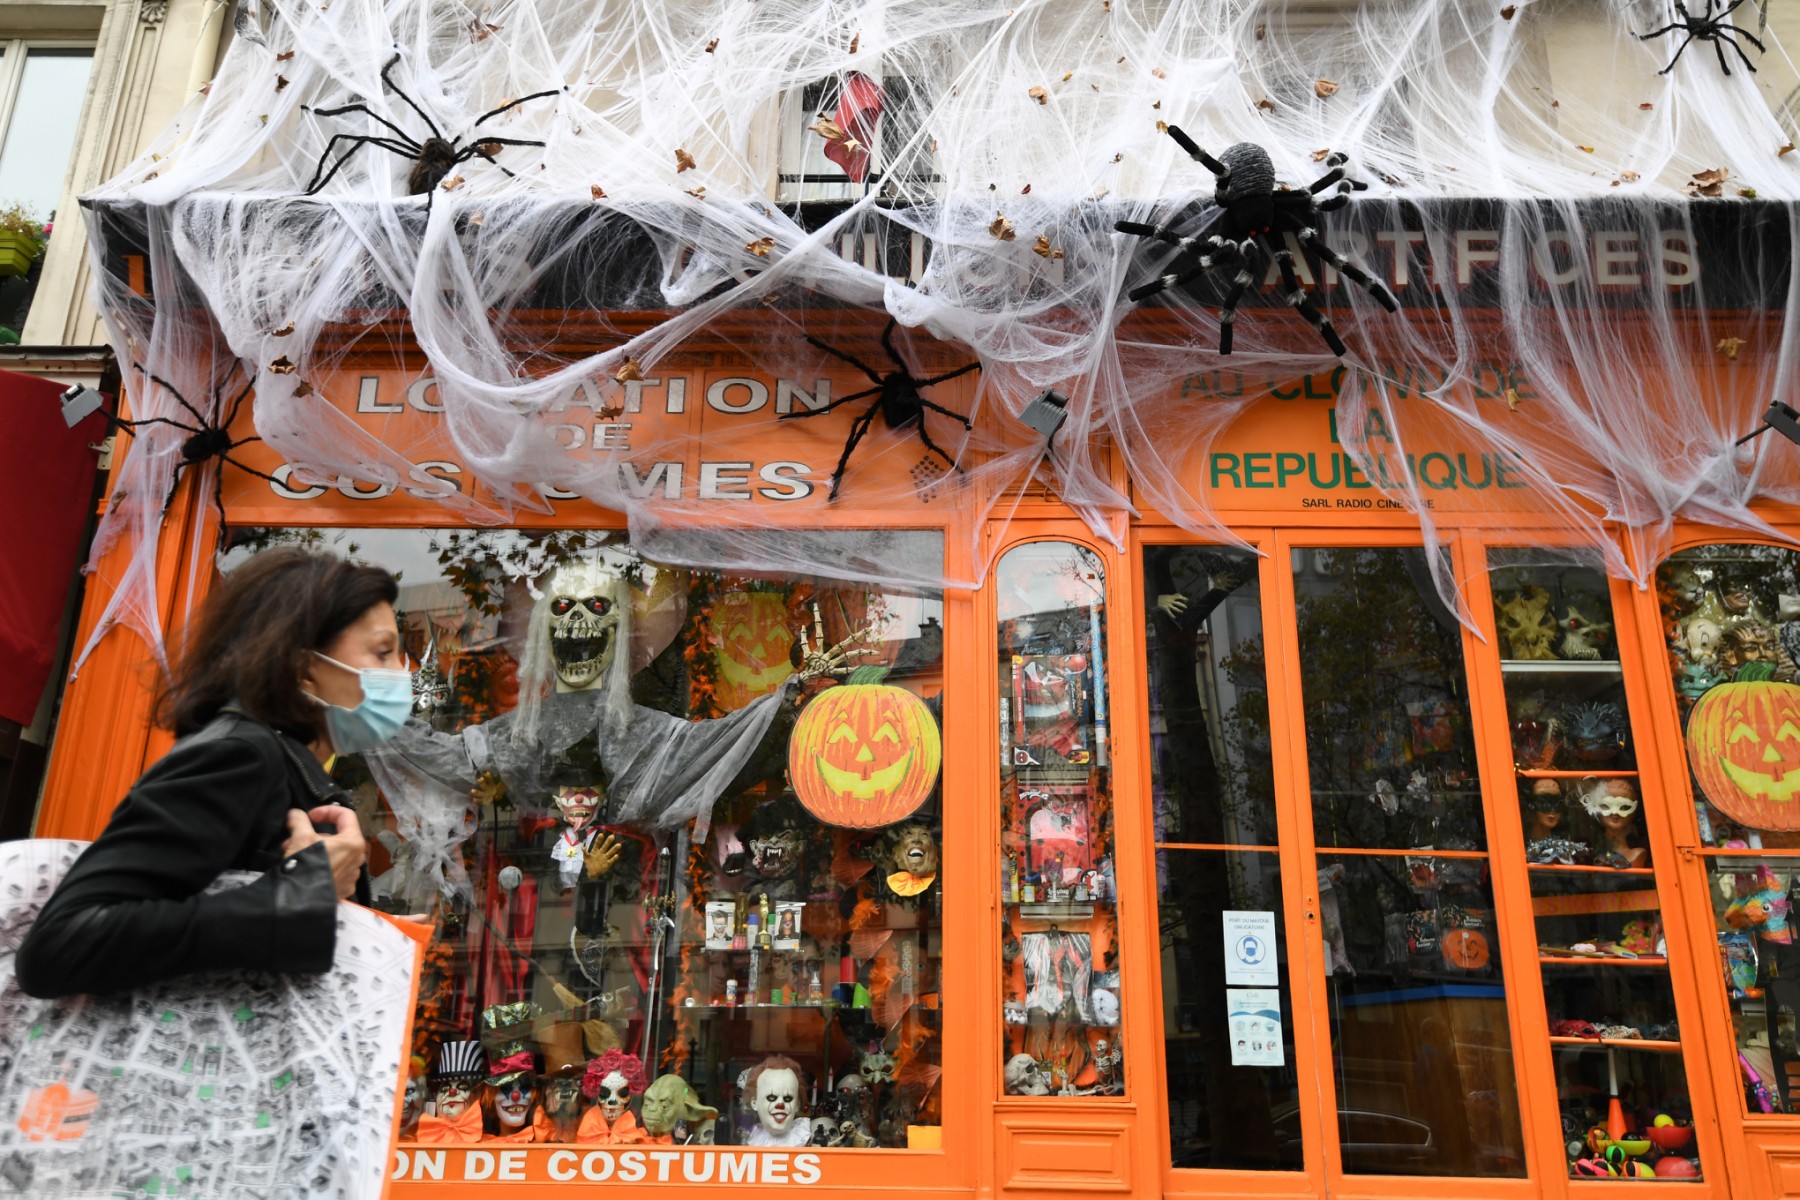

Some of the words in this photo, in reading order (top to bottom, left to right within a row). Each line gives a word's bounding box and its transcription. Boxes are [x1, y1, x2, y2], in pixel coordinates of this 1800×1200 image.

[357, 376, 832, 415] LOATION
[1180, 369, 1243, 399] AU
[1473, 364, 1539, 399] DE
[546, 422, 633, 451] DE
[1328, 407, 1393, 444] LA
[1209, 452, 1528, 490] REPUBLIQUE
[1302, 498, 1332, 508] SARL
[1336, 498, 1372, 509] RADIO
[464, 1150, 528, 1181] DE
[547, 1149, 822, 1185] COSTUMES
